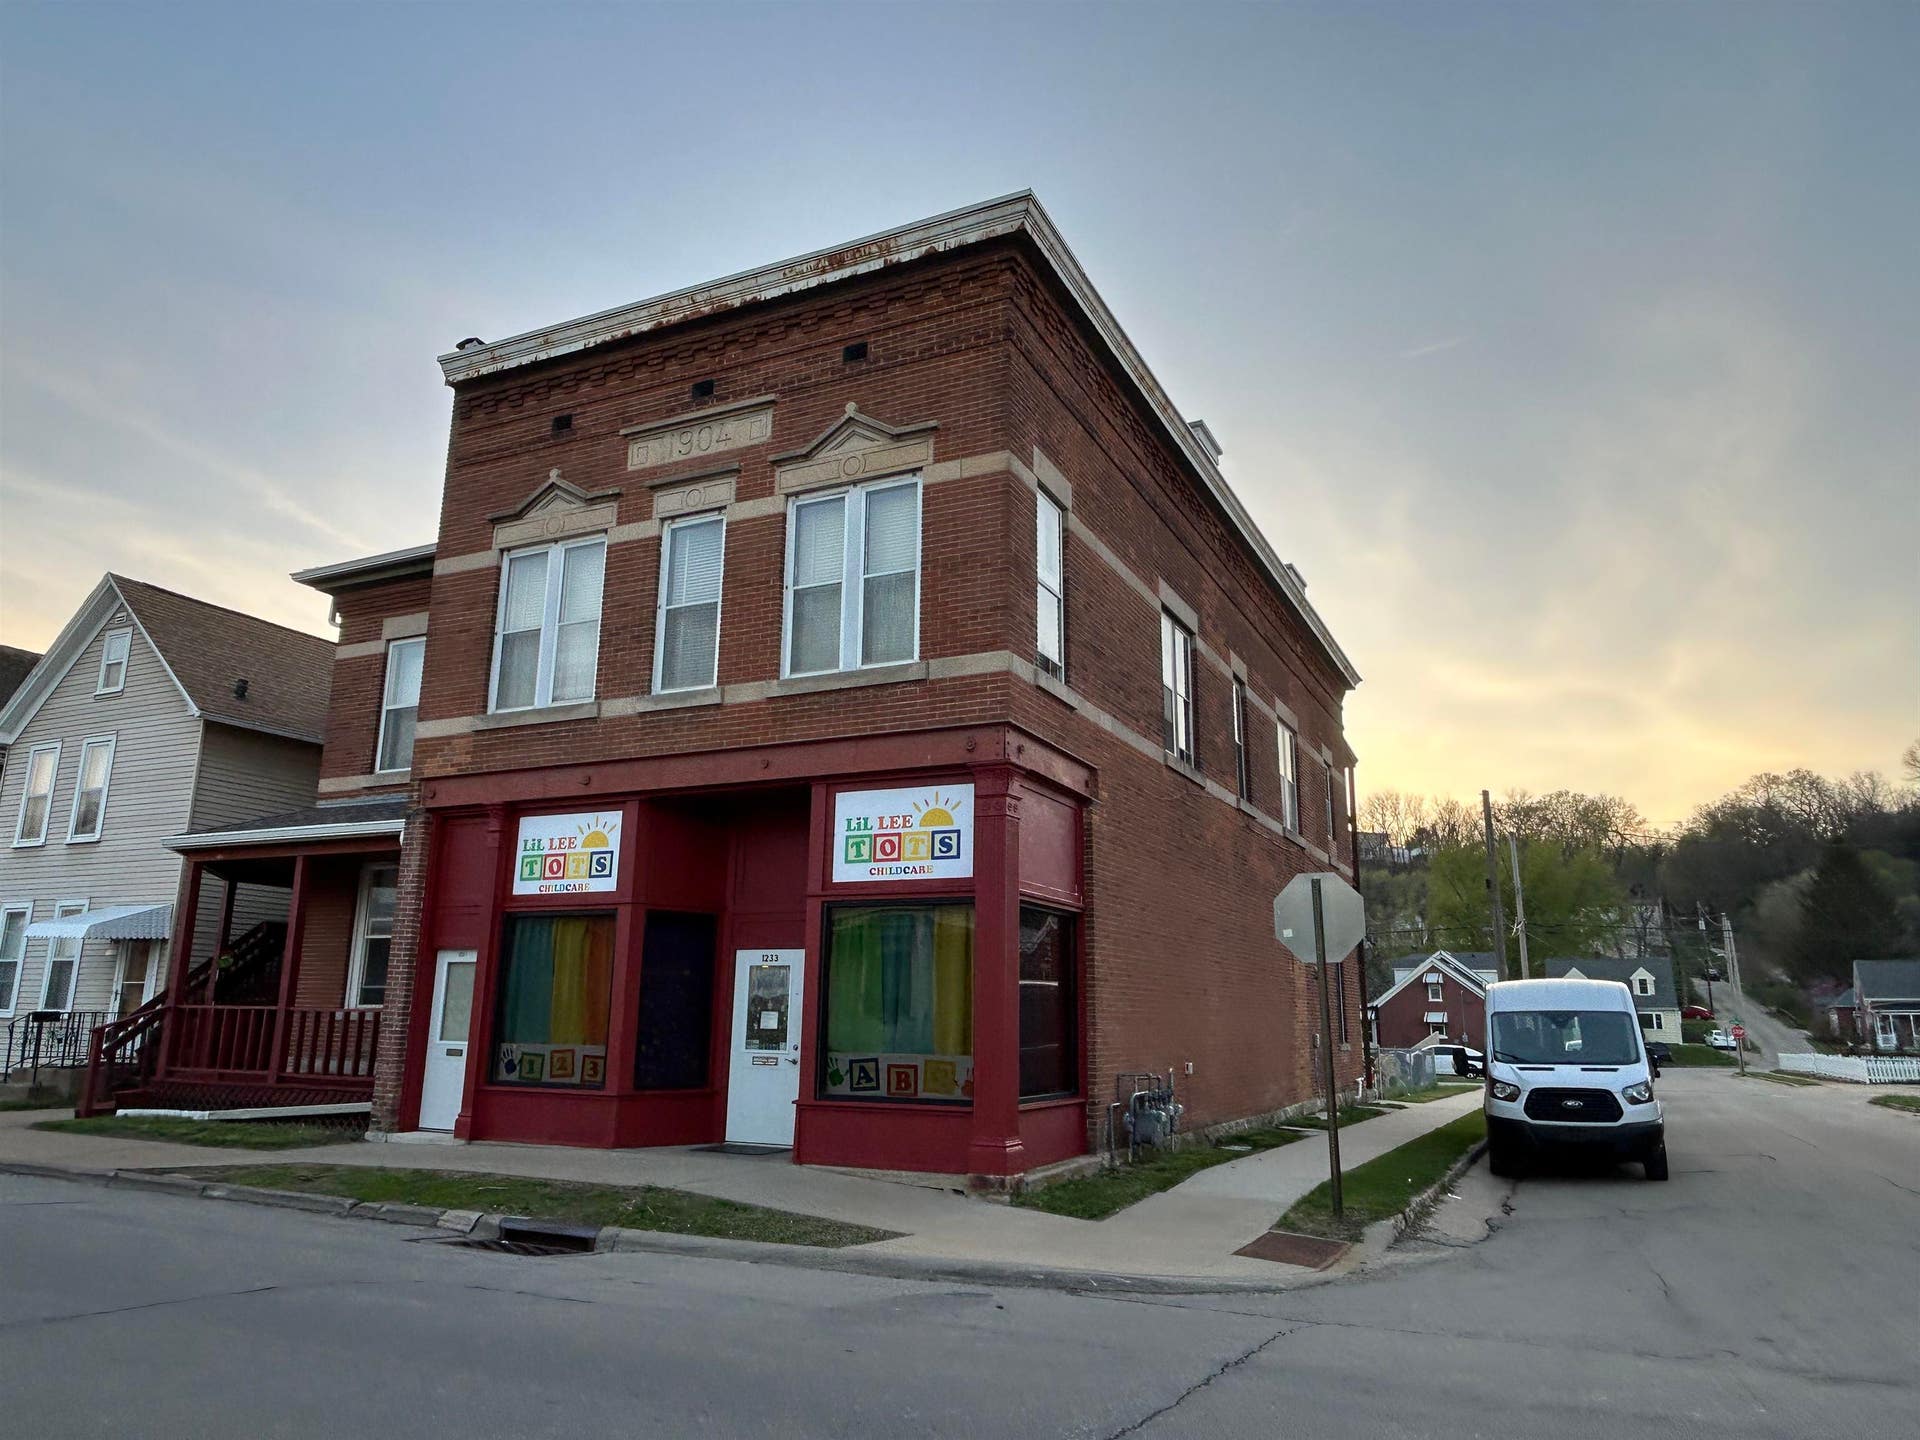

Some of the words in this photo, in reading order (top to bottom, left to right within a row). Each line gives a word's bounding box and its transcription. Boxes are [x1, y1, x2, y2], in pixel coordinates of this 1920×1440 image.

[668, 422, 732, 457] 1904
[877, 814, 914, 830] LEE
[548, 836, 578, 851] LEE
[849, 834, 954, 859] TOTS
[523, 854, 609, 878] TOTS
[869, 865, 934, 876] CHILDCARE
[538, 882, 590, 893] CHILDCARE
[762, 954, 779, 962] 1233
